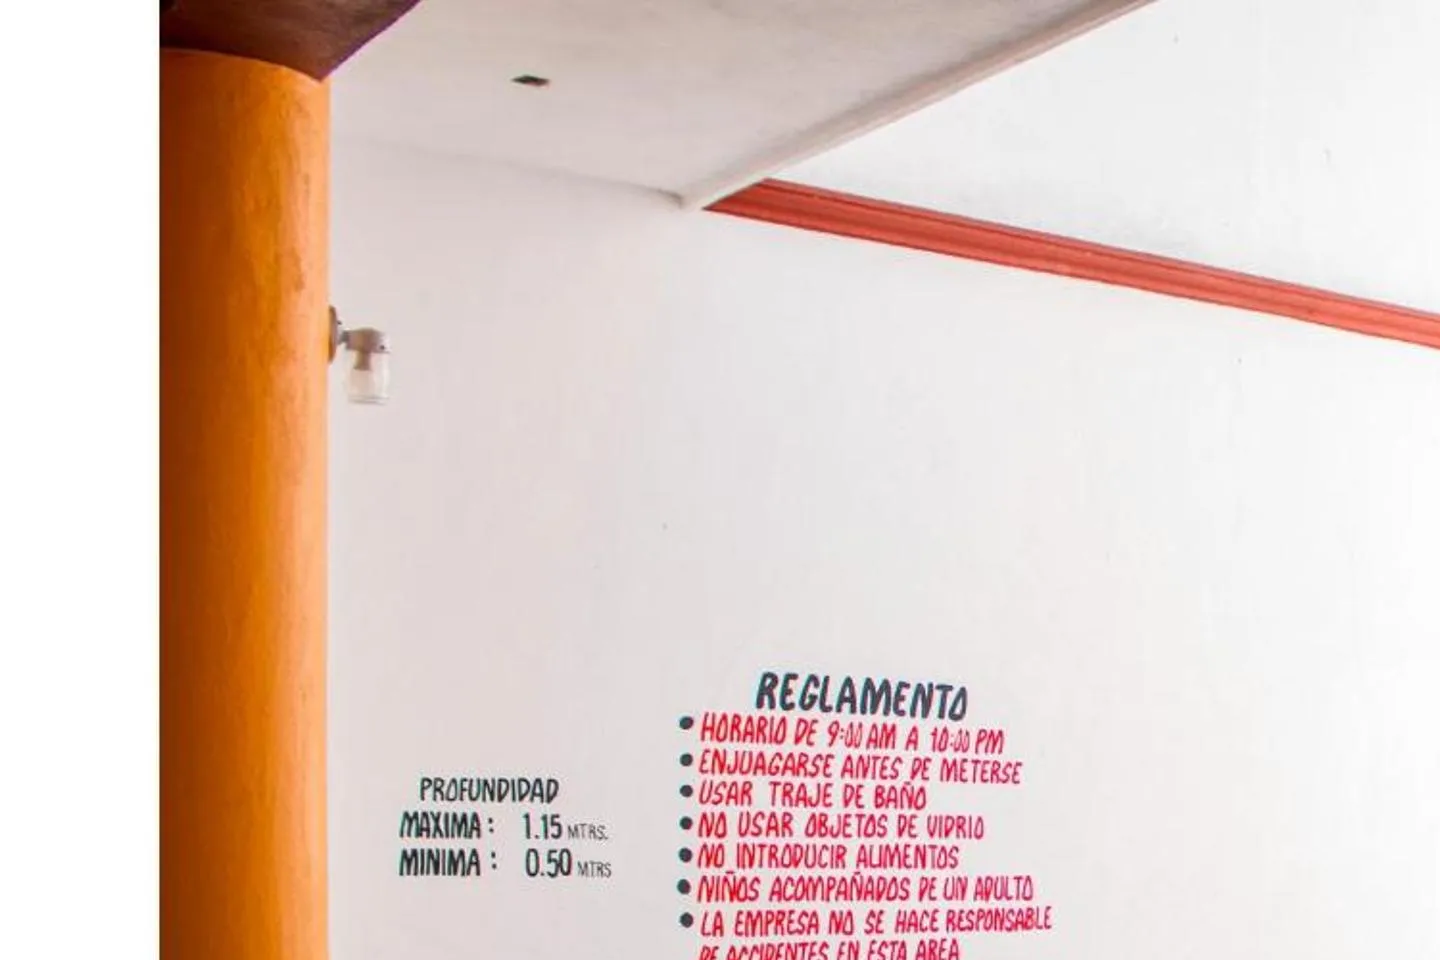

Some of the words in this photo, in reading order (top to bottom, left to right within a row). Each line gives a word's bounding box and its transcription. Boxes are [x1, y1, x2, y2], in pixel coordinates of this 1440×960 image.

[755, 672, 968, 721] REGLAMENTO
[700, 712, 787, 744] HORARIO
[795, 718, 819, 746] DE
[827, 721, 861, 748] 9:00
[866, 724, 896, 750] AM
[905, 725, 919, 751] A
[930, 727, 970, 753] 10:00
[974, 729, 1005, 754] PM
[699, 749, 835, 779] ENJUAGARSE
[841, 755, 899, 780] ANTES
[910, 758, 930, 782] DE
[940, 758, 1023, 785] METERSE
[420, 777, 559, 803] PROFUNDIDAD
[699, 781, 753, 806] USAR
[769, 782, 833, 808] TRAJE
[842, 784, 865, 808] DE
[874, 782, 926, 811] BAÑO
[522, 813, 562, 840] 1.15
[698, 811, 727, 838] NO
[738, 811, 793, 838] USAR
[805, 812, 888, 839] OBJETOS
[898, 814, 918, 839] DE
[927, 815, 984, 840] VIDRIO
[525, 848, 572, 878] 0.50
[697, 844, 724, 869] NO
[737, 844, 847, 869] INTRODUCIR
[856, 845, 959, 870] ALIMENTOS
[697, 870, 760, 903] NIÑOS
[769, 872, 910, 902] ACOMPAÑADOS
[919, 876, 938, 902] DE
[944, 876, 968, 901] UN
[974, 875, 1033, 901] ADULTO
[700, 911, 724, 937] LA
[735, 910, 819, 936] EMPRESA
[829, 910, 854, 935] NO
[864, 910, 885, 934] SE
[895, 909, 940, 934] HACE
[946, 906, 1052, 932] RESPONSABLE
